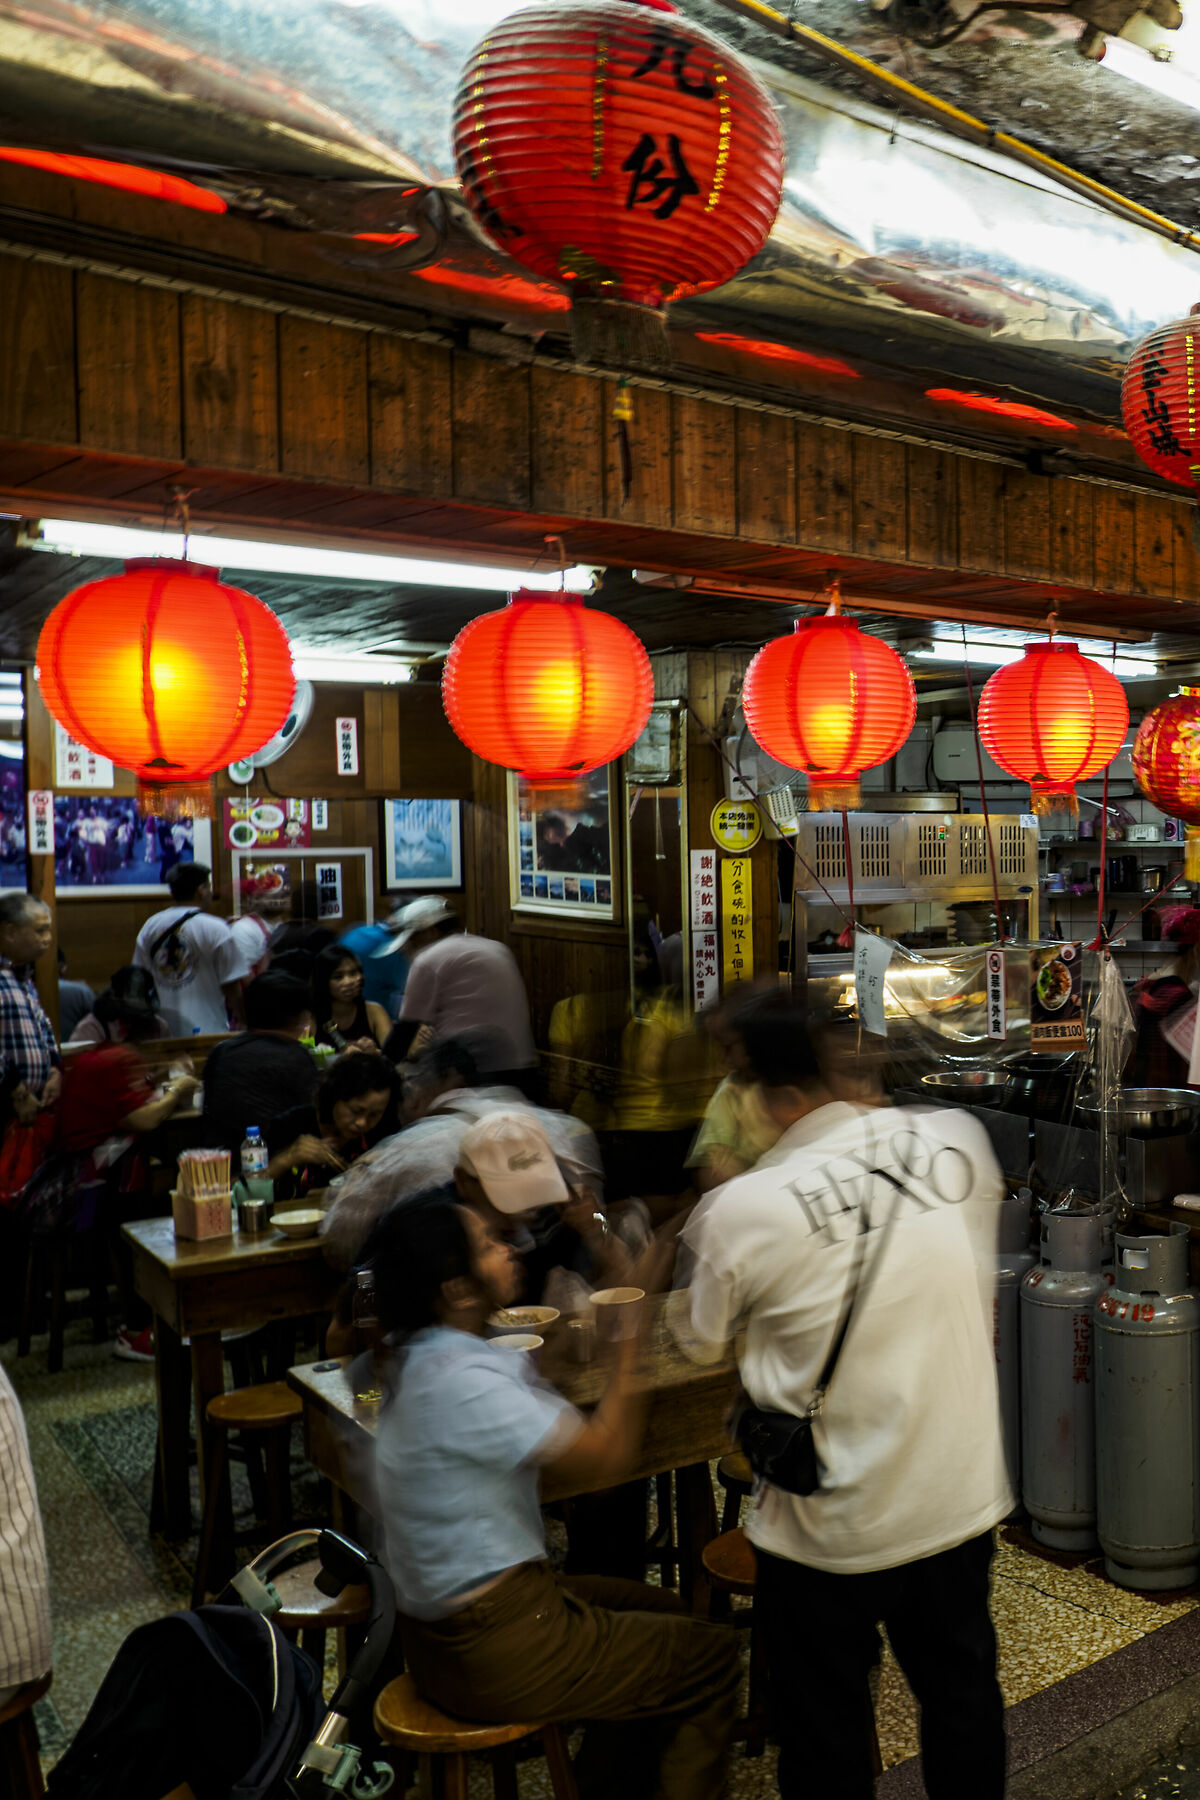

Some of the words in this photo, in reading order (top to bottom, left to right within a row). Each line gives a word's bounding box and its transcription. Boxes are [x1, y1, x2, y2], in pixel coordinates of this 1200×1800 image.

[622, 26, 717, 220] 九份
[700, 856, 714, 925] 謝絕飲酒
[704, 934, 716, 977] 福州丸
[990, 974, 1002, 1033] 禁帶外食
[1072, 1313, 1091, 1384] 液化石油氣
